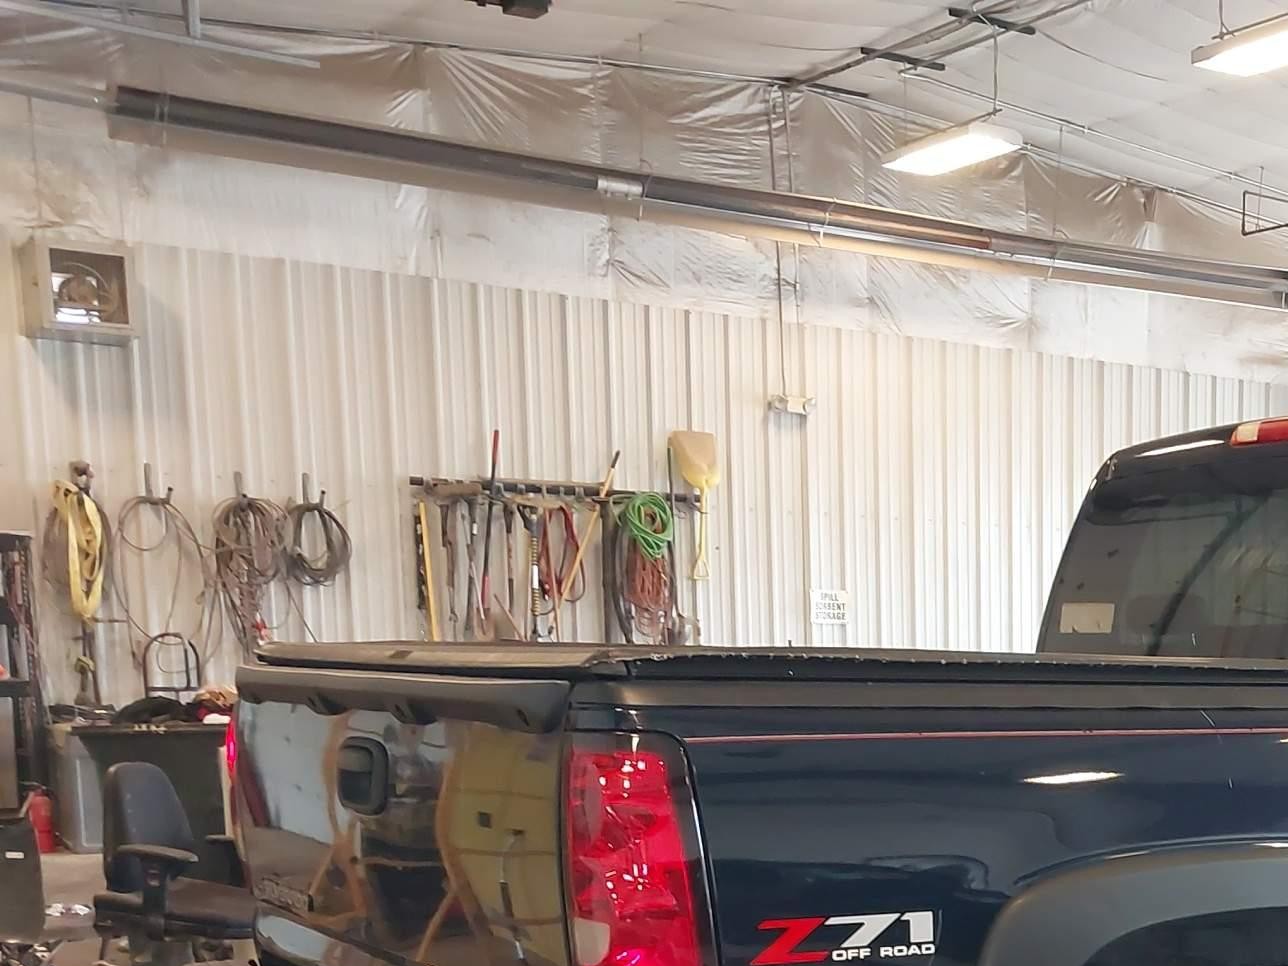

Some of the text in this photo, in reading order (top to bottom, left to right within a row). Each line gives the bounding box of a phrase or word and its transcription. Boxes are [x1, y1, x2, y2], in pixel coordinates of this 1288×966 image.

[820, 592, 839, 602] SPILL
[816, 611, 846, 621] STORAGE
[748, 910, 935, 966] Z71
[831, 943, 936, 962] OFF ROAD
